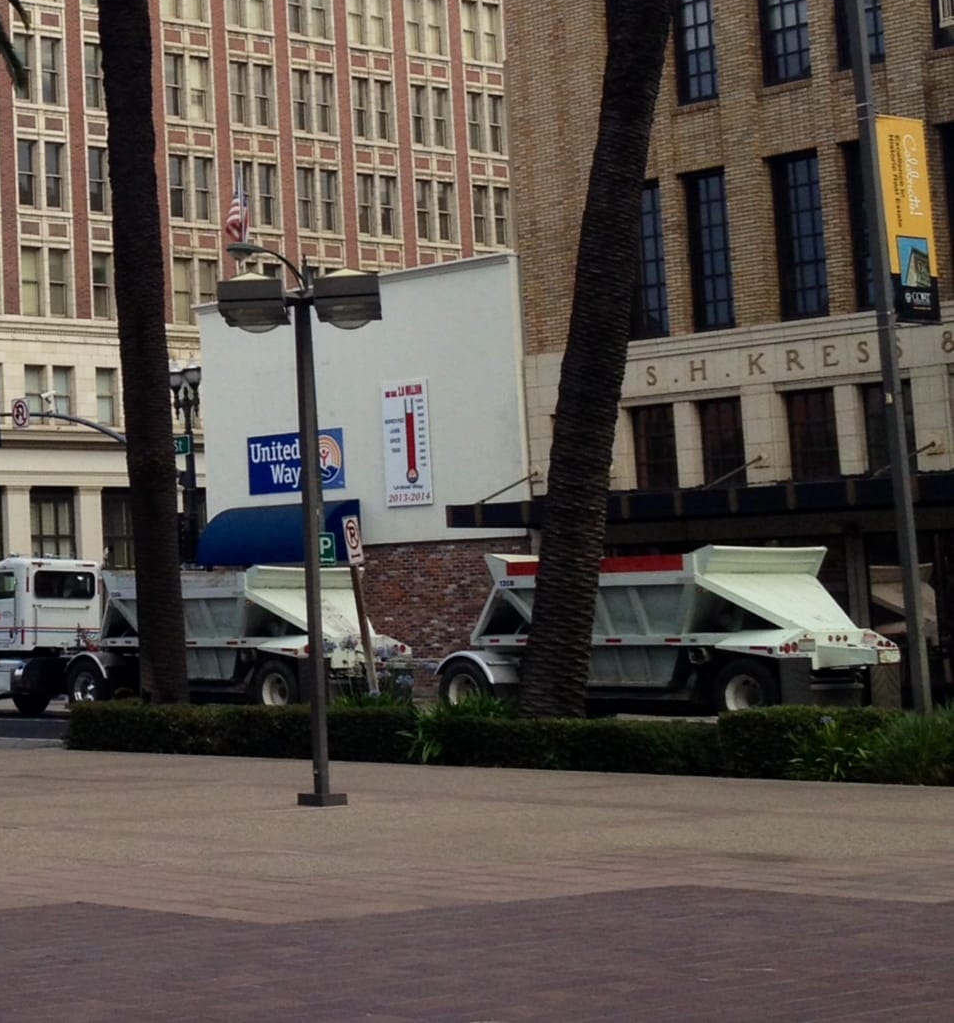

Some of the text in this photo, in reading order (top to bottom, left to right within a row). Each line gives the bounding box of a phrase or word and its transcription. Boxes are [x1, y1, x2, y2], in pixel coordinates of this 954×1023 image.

[250, 438, 301, 463] United
[270, 463, 302, 489] Way
[388, 492, 430, 503] 2013-2014
[319, 537, 332, 555] P
